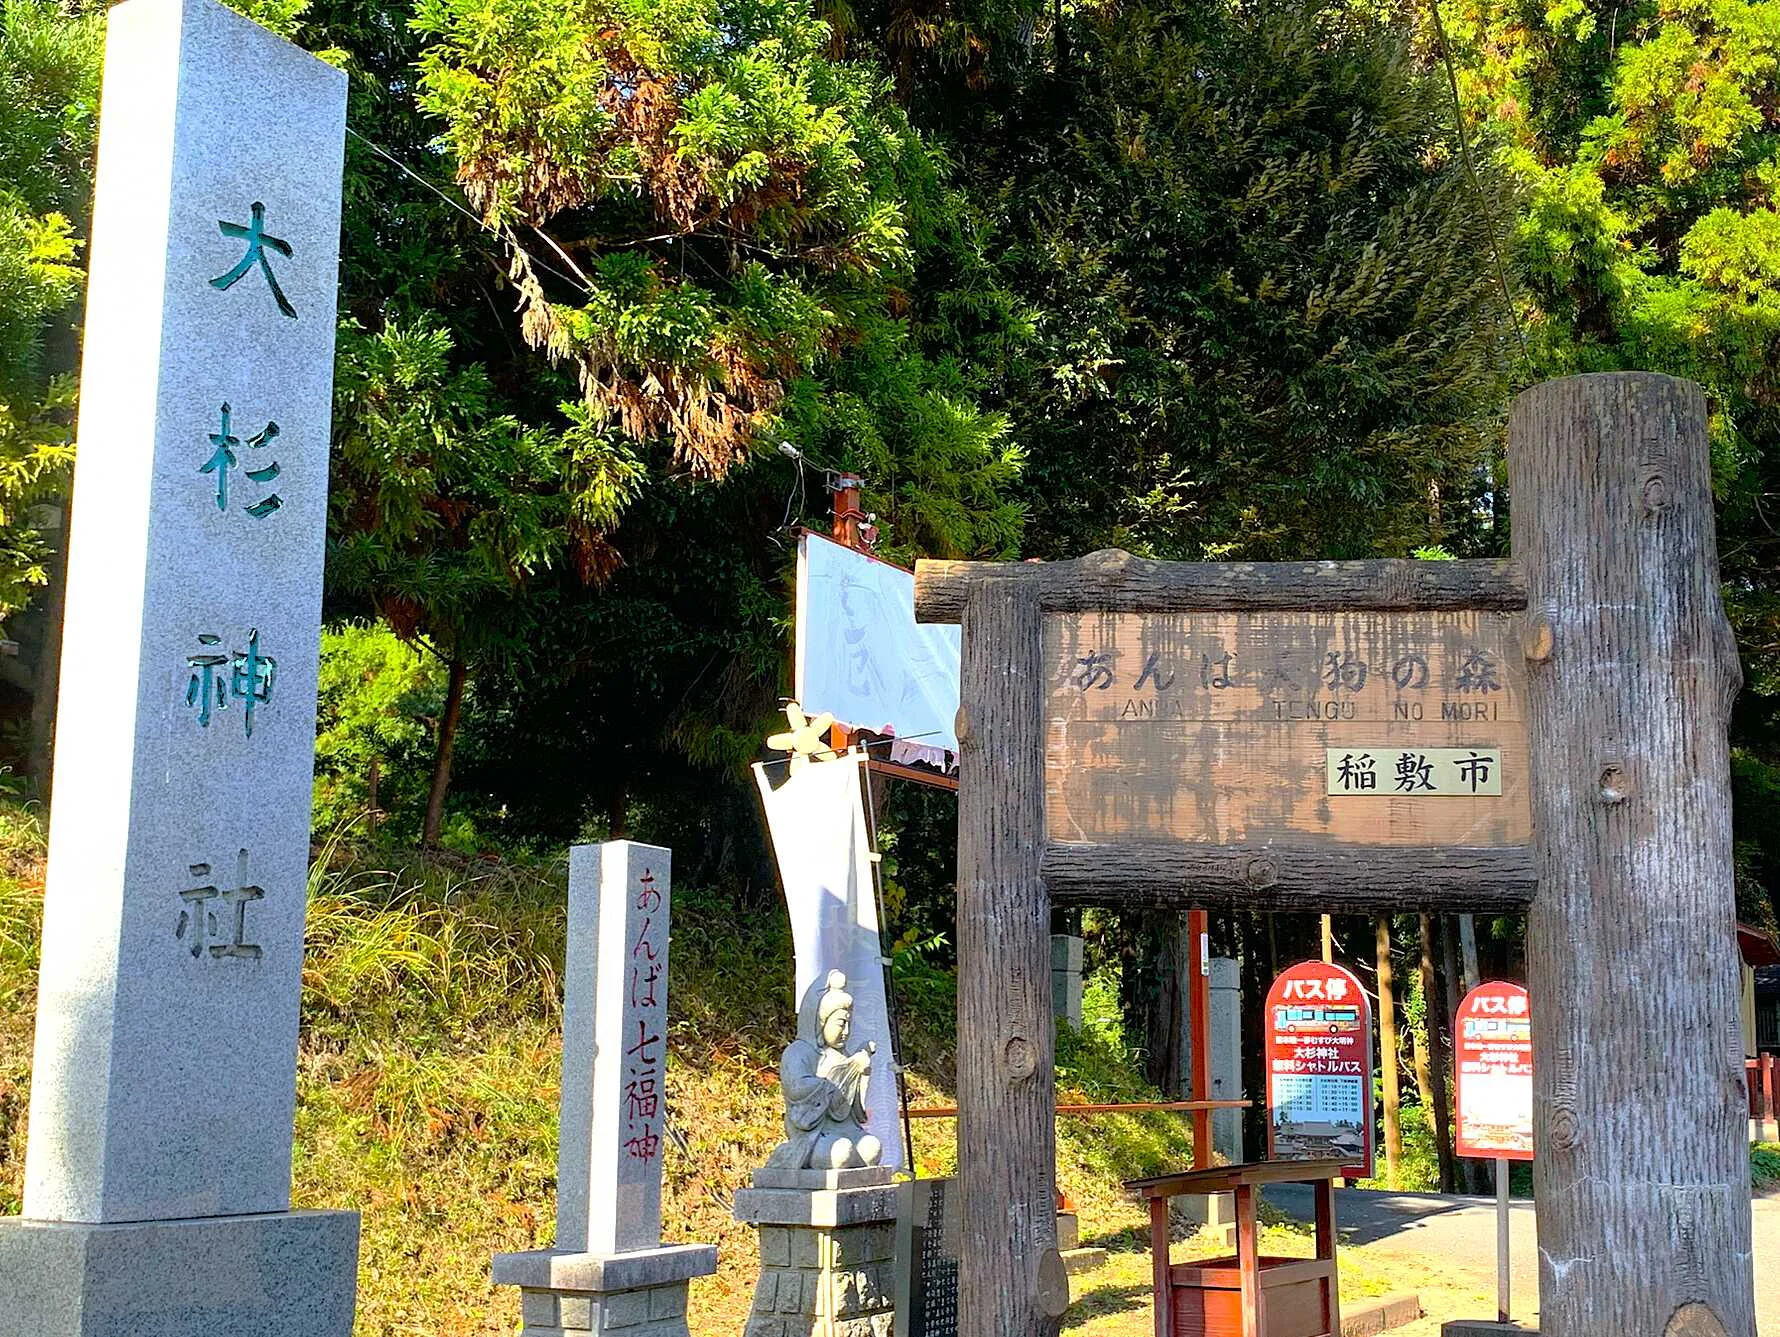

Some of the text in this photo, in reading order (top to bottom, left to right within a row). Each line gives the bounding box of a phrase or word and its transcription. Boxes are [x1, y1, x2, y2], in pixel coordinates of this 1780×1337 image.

[176, 201, 299, 963] 大杉神社
[1121, 699, 1499, 721] ANA TENGU NO MORI
[1335, 751, 1495, 794] 稲敷市
[1282, 978, 1347, 1000] バス停
[623, 867, 663, 1176] あんば七福神
[1293, 1047, 1340, 1060] 大杉神社
[1271, 1059, 1362, 1074] 無料シャトルバス
